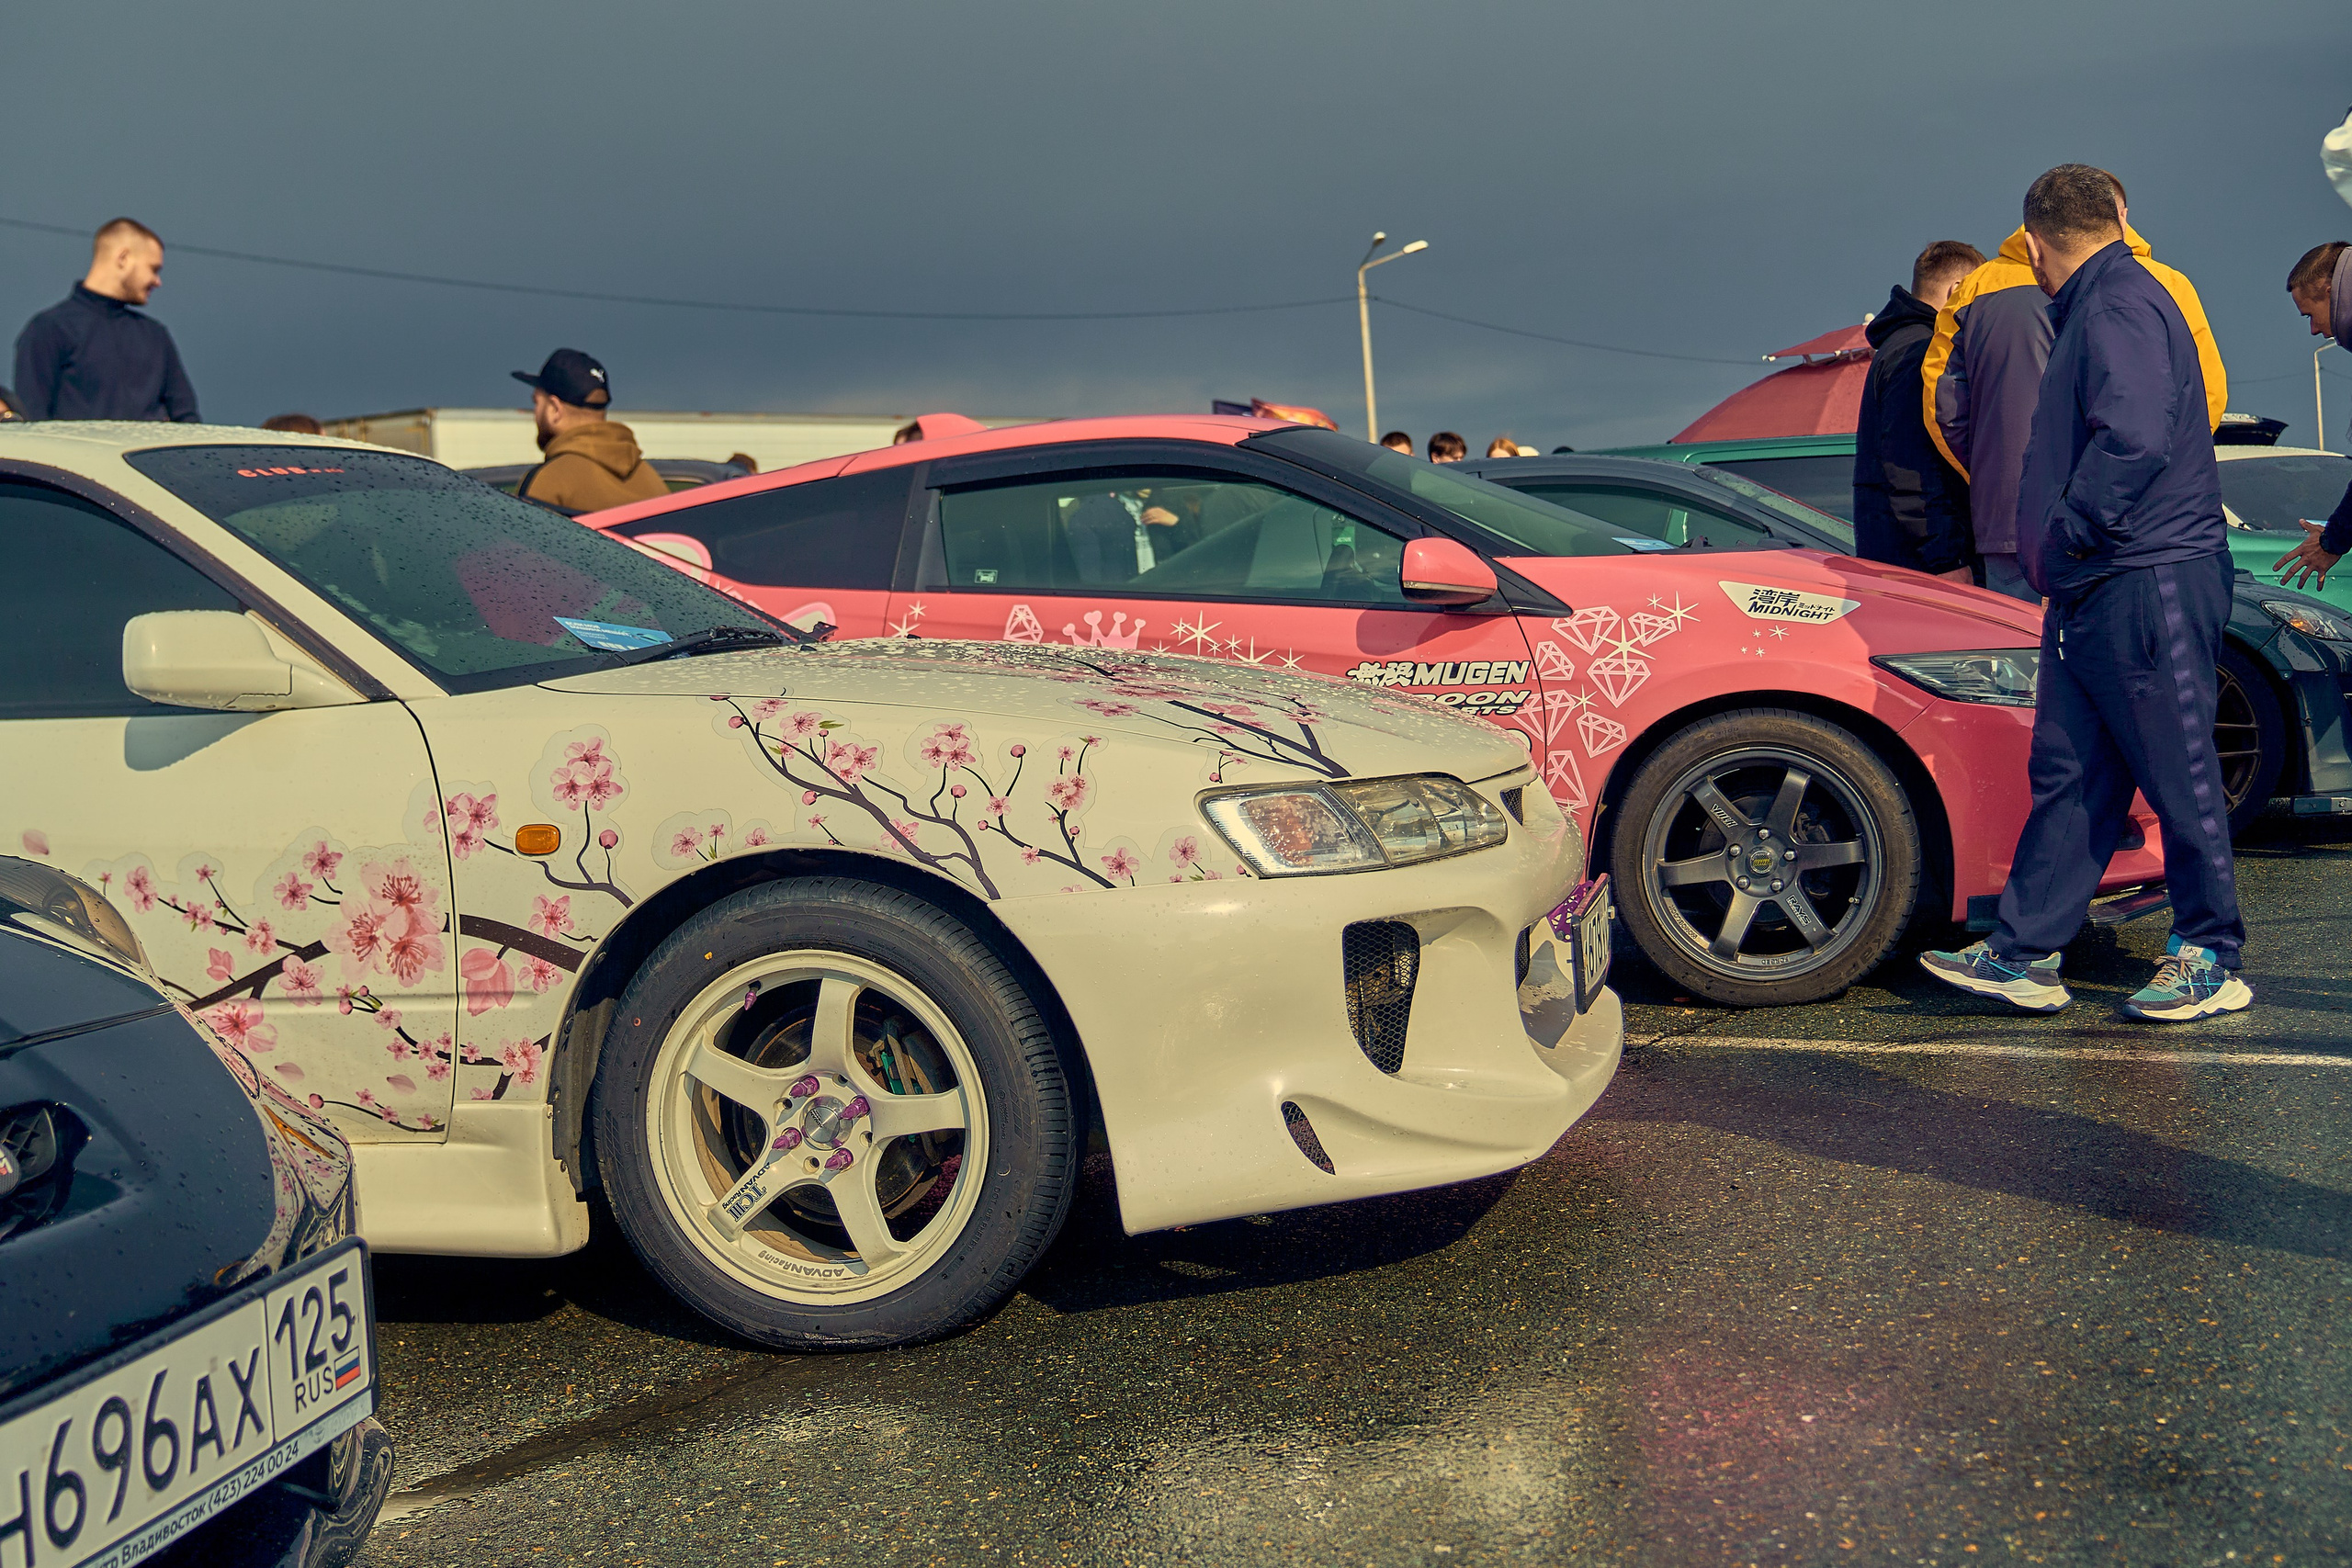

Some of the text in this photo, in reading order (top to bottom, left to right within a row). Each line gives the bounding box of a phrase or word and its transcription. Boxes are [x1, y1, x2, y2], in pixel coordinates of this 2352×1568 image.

[1748, 588, 1801, 606] 湾岸
[1747, 602, 1834, 620] MIDNIGHT
[1412, 660, 1531, 686] MUGEN
[1460, 705, 1519, 716] RTS
[1787, 895, 1812, 924] RAYS
[274, 1268, 355, 1382] 125
[294, 1367, 334, 1415] RUS
[121, 1501, 207, 1565] Владивосток
[208, 1477, 242, 1514] (423)
[243, 1463, 266, 1488] 224
[267, 1451, 285, 1474] 00
[286, 1440, 300, 1461] 24
